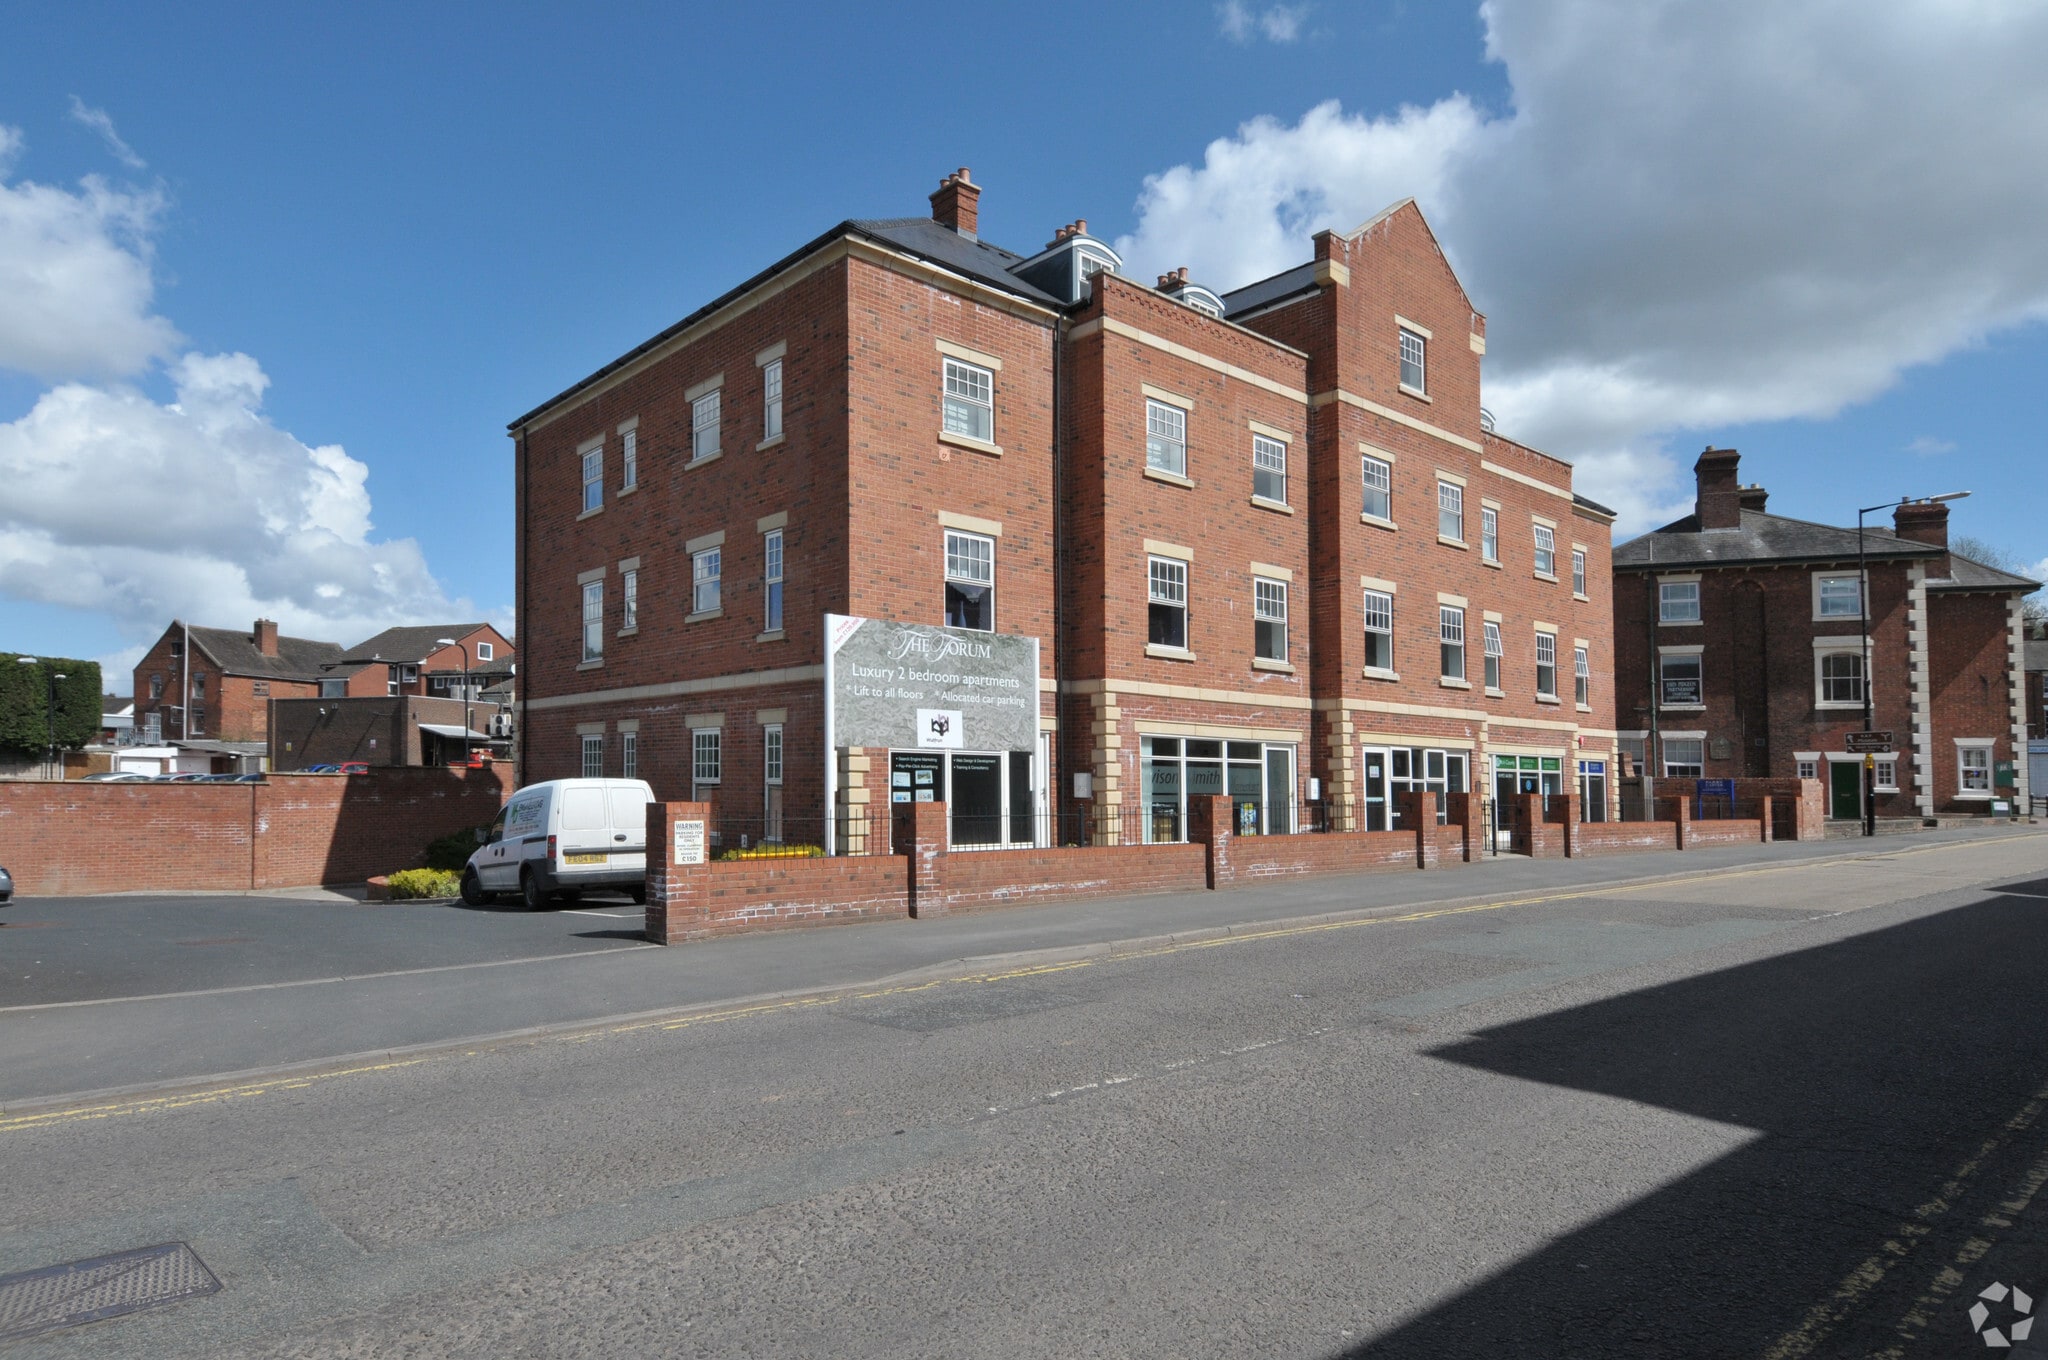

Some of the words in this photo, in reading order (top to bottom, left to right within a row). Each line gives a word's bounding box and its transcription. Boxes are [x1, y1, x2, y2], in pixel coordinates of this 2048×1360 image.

[887, 628, 931, 660] THE
[925, 631, 991, 662] FORUM
[852, 663, 894, 682] Luxury
[898, 666, 905, 680] 2
[909, 667, 959, 684] bedroom
[962, 674, 1020, 688] apartments
[854, 685, 869, 696] Lift
[872, 689, 882, 697] to
[885, 687, 895, 698] all
[898, 688, 924, 699] floors
[941, 691, 980, 704] Allocated
[982, 696, 994, 704] car
[997, 695, 1025, 708] parking
